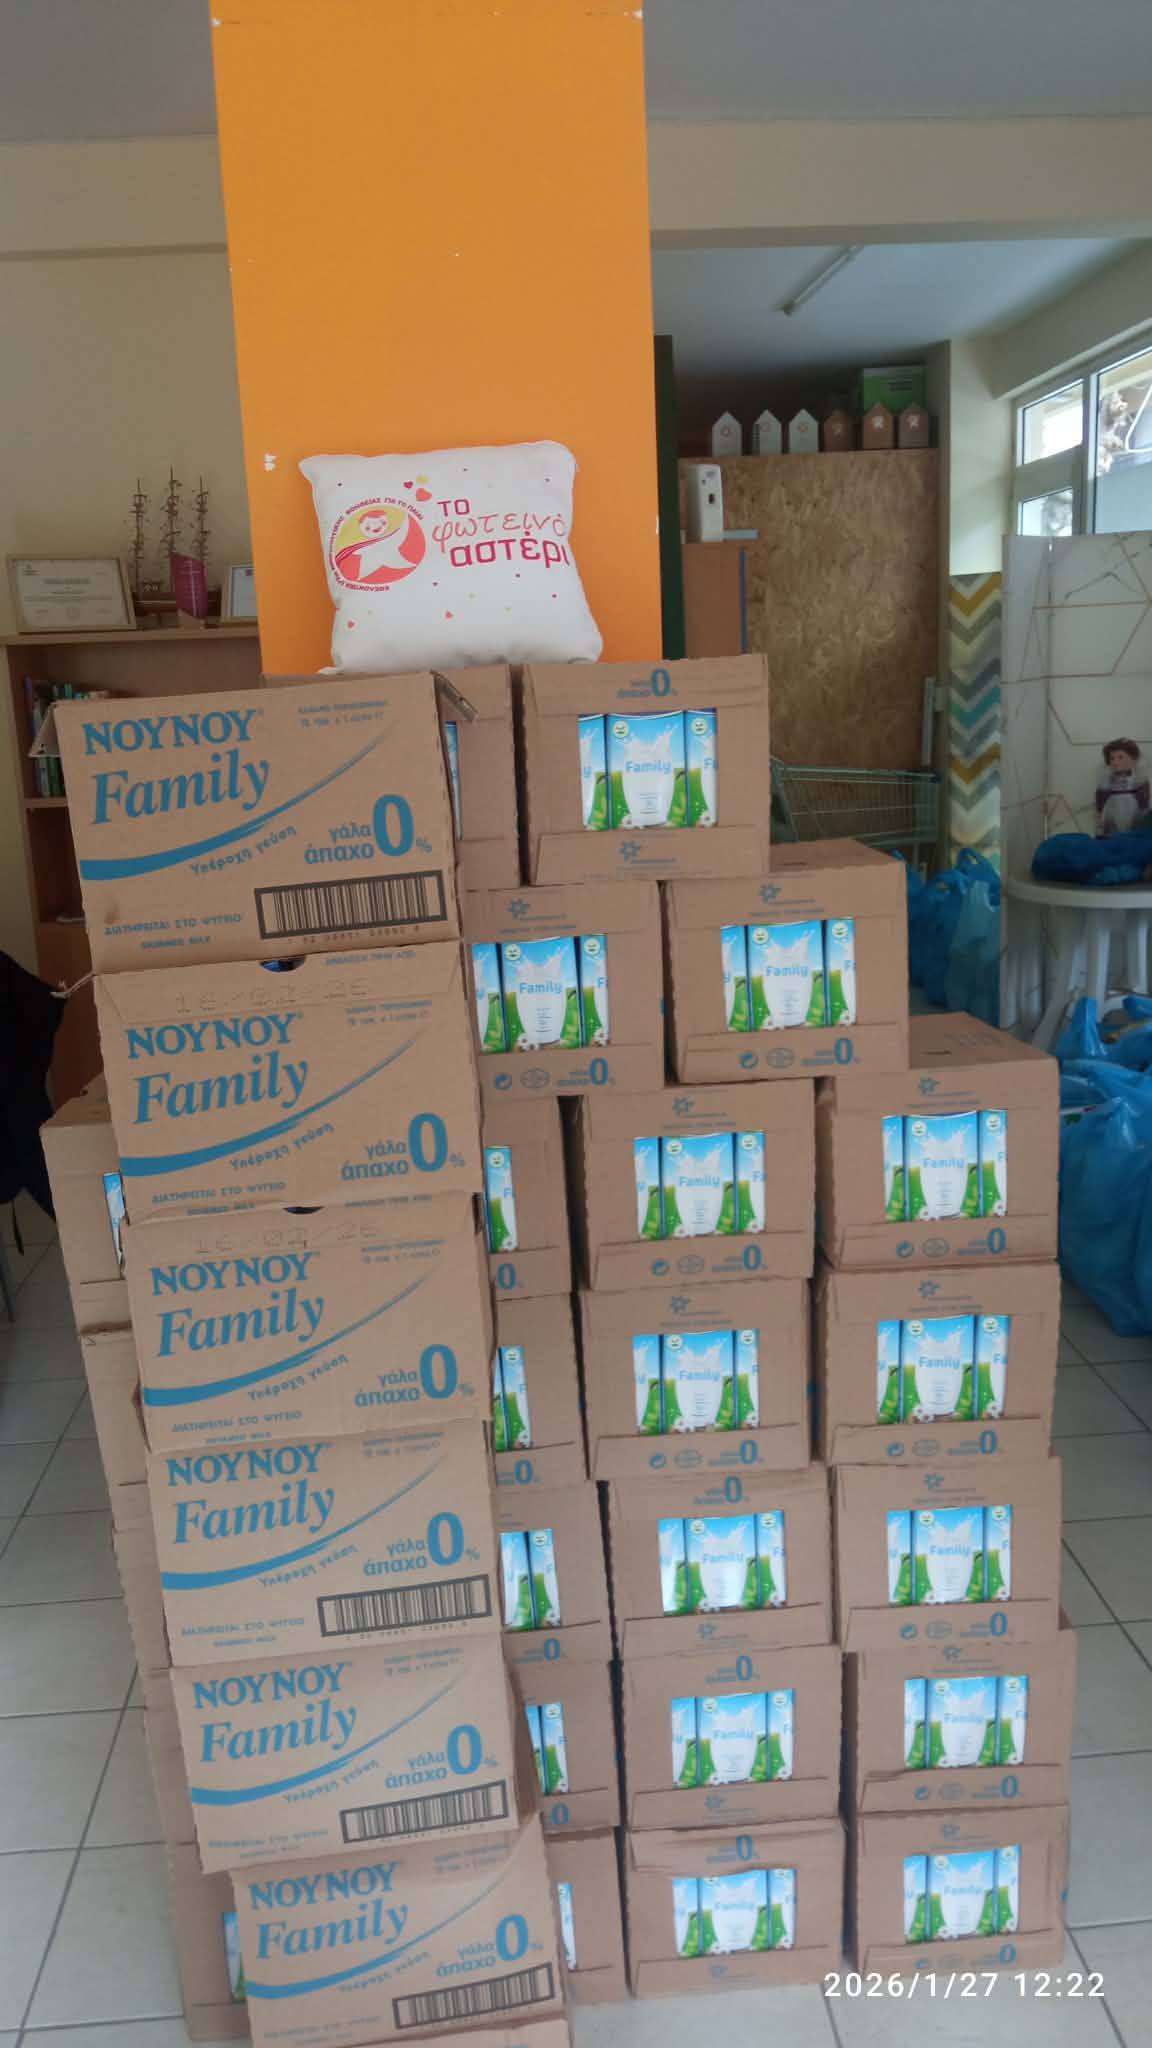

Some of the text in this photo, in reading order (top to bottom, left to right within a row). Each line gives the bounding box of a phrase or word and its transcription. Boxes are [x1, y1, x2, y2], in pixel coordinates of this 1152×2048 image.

[432, 513, 566, 554] φωτεινό
[449, 532, 570, 568] αστέρι
[625, 759, 672, 774] Family
[92, 749, 270, 825] Family
[328, 823, 372, 841] γάλα
[188, 848, 253, 877] Υπέροχη
[304, 842, 374, 865] άπαχο
[766, 965, 808, 977] Family
[519, 982, 563, 994] Family
[834, 1037, 859, 1065] 0
[589, 1057, 615, 1086] 0
[132, 1050, 308, 1125] Family
[229, 1143, 291, 1171] Υπέροχη
[365, 1140, 407, 1158] γάλα
[341, 1158, 408, 1182] άπαχο
[679, 1176, 720, 1187] Family
[743, 1244, 767, 1270] 0
[156, 1287, 324, 1358] Family
[919, 1356, 961, 1369] Family
[247, 1375, 305, 1401] Υπέροχη
[377, 1368, 417, 1387] γάλα
[354, 1386, 420, 1408] άπαχο
[740, 1439, 763, 1465] 0
[725, 1475, 749, 1504] 0
[173, 1479, 335, 1545] Family
[930, 1545, 971, 1557] Family
[362, 1554, 427, 1577] άπαχο
[736, 1655, 760, 1681] 0
[199, 1698, 357, 1763] Family
[385, 1766, 447, 1790] άπαχο
[736, 1835, 760, 1861] 0
[256, 1898, 408, 1960] Family
[436, 1955, 496, 1978] άπαχο
